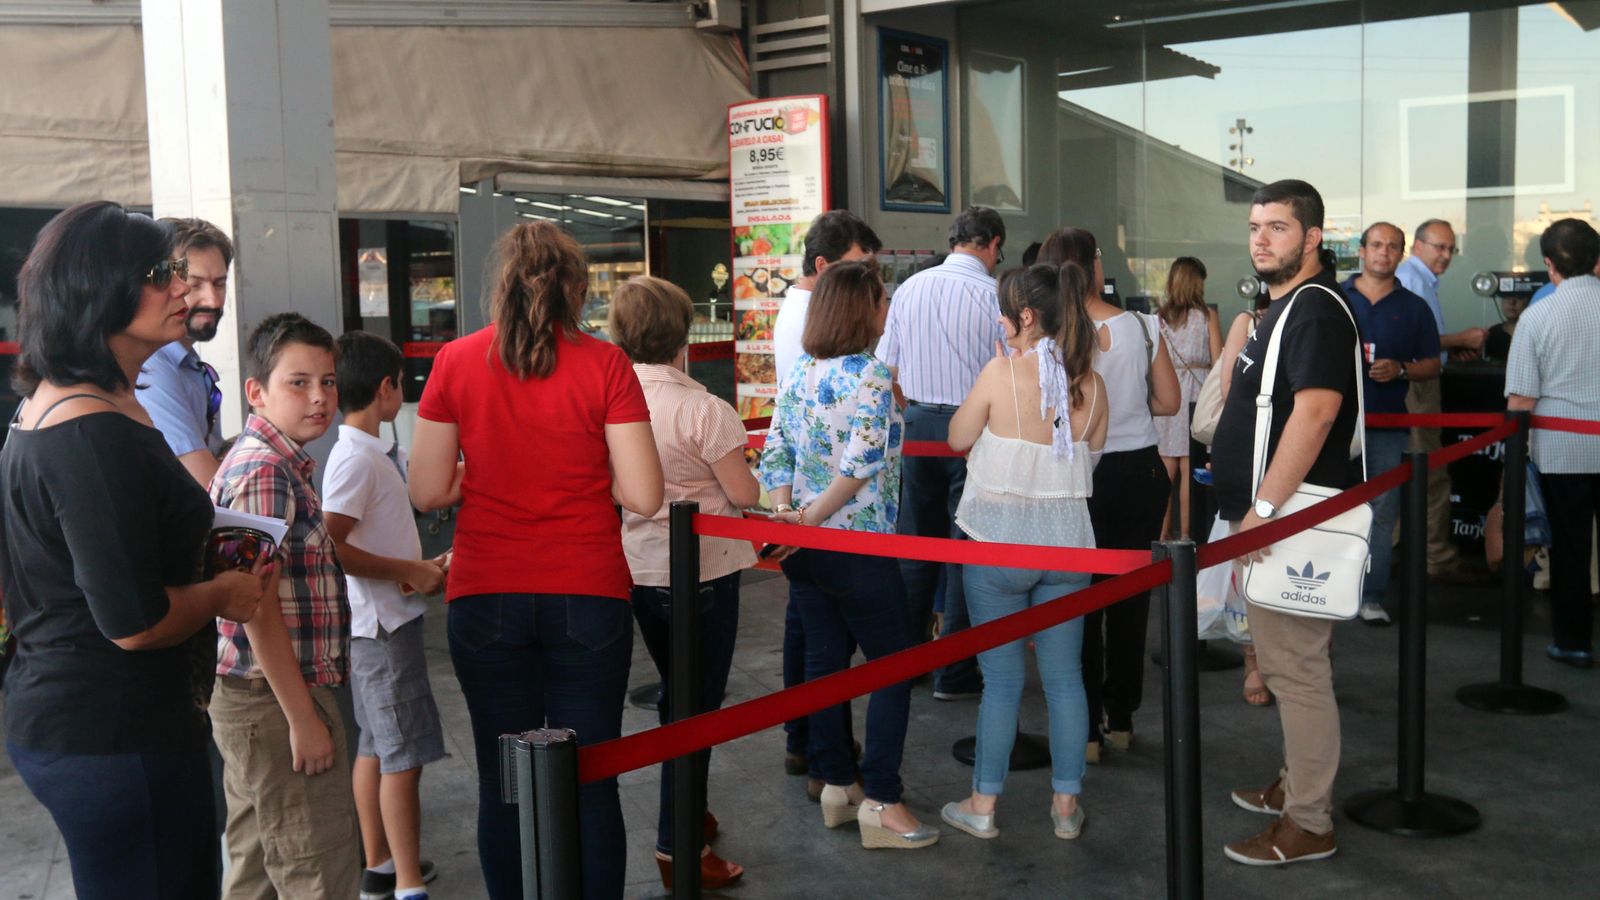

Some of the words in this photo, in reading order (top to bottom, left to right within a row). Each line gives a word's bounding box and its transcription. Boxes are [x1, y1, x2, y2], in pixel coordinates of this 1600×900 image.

[729, 117, 784, 135] CONFUCIO
[749, 146, 784, 164] 8,95€
[1281, 590, 1327, 605] adidas
